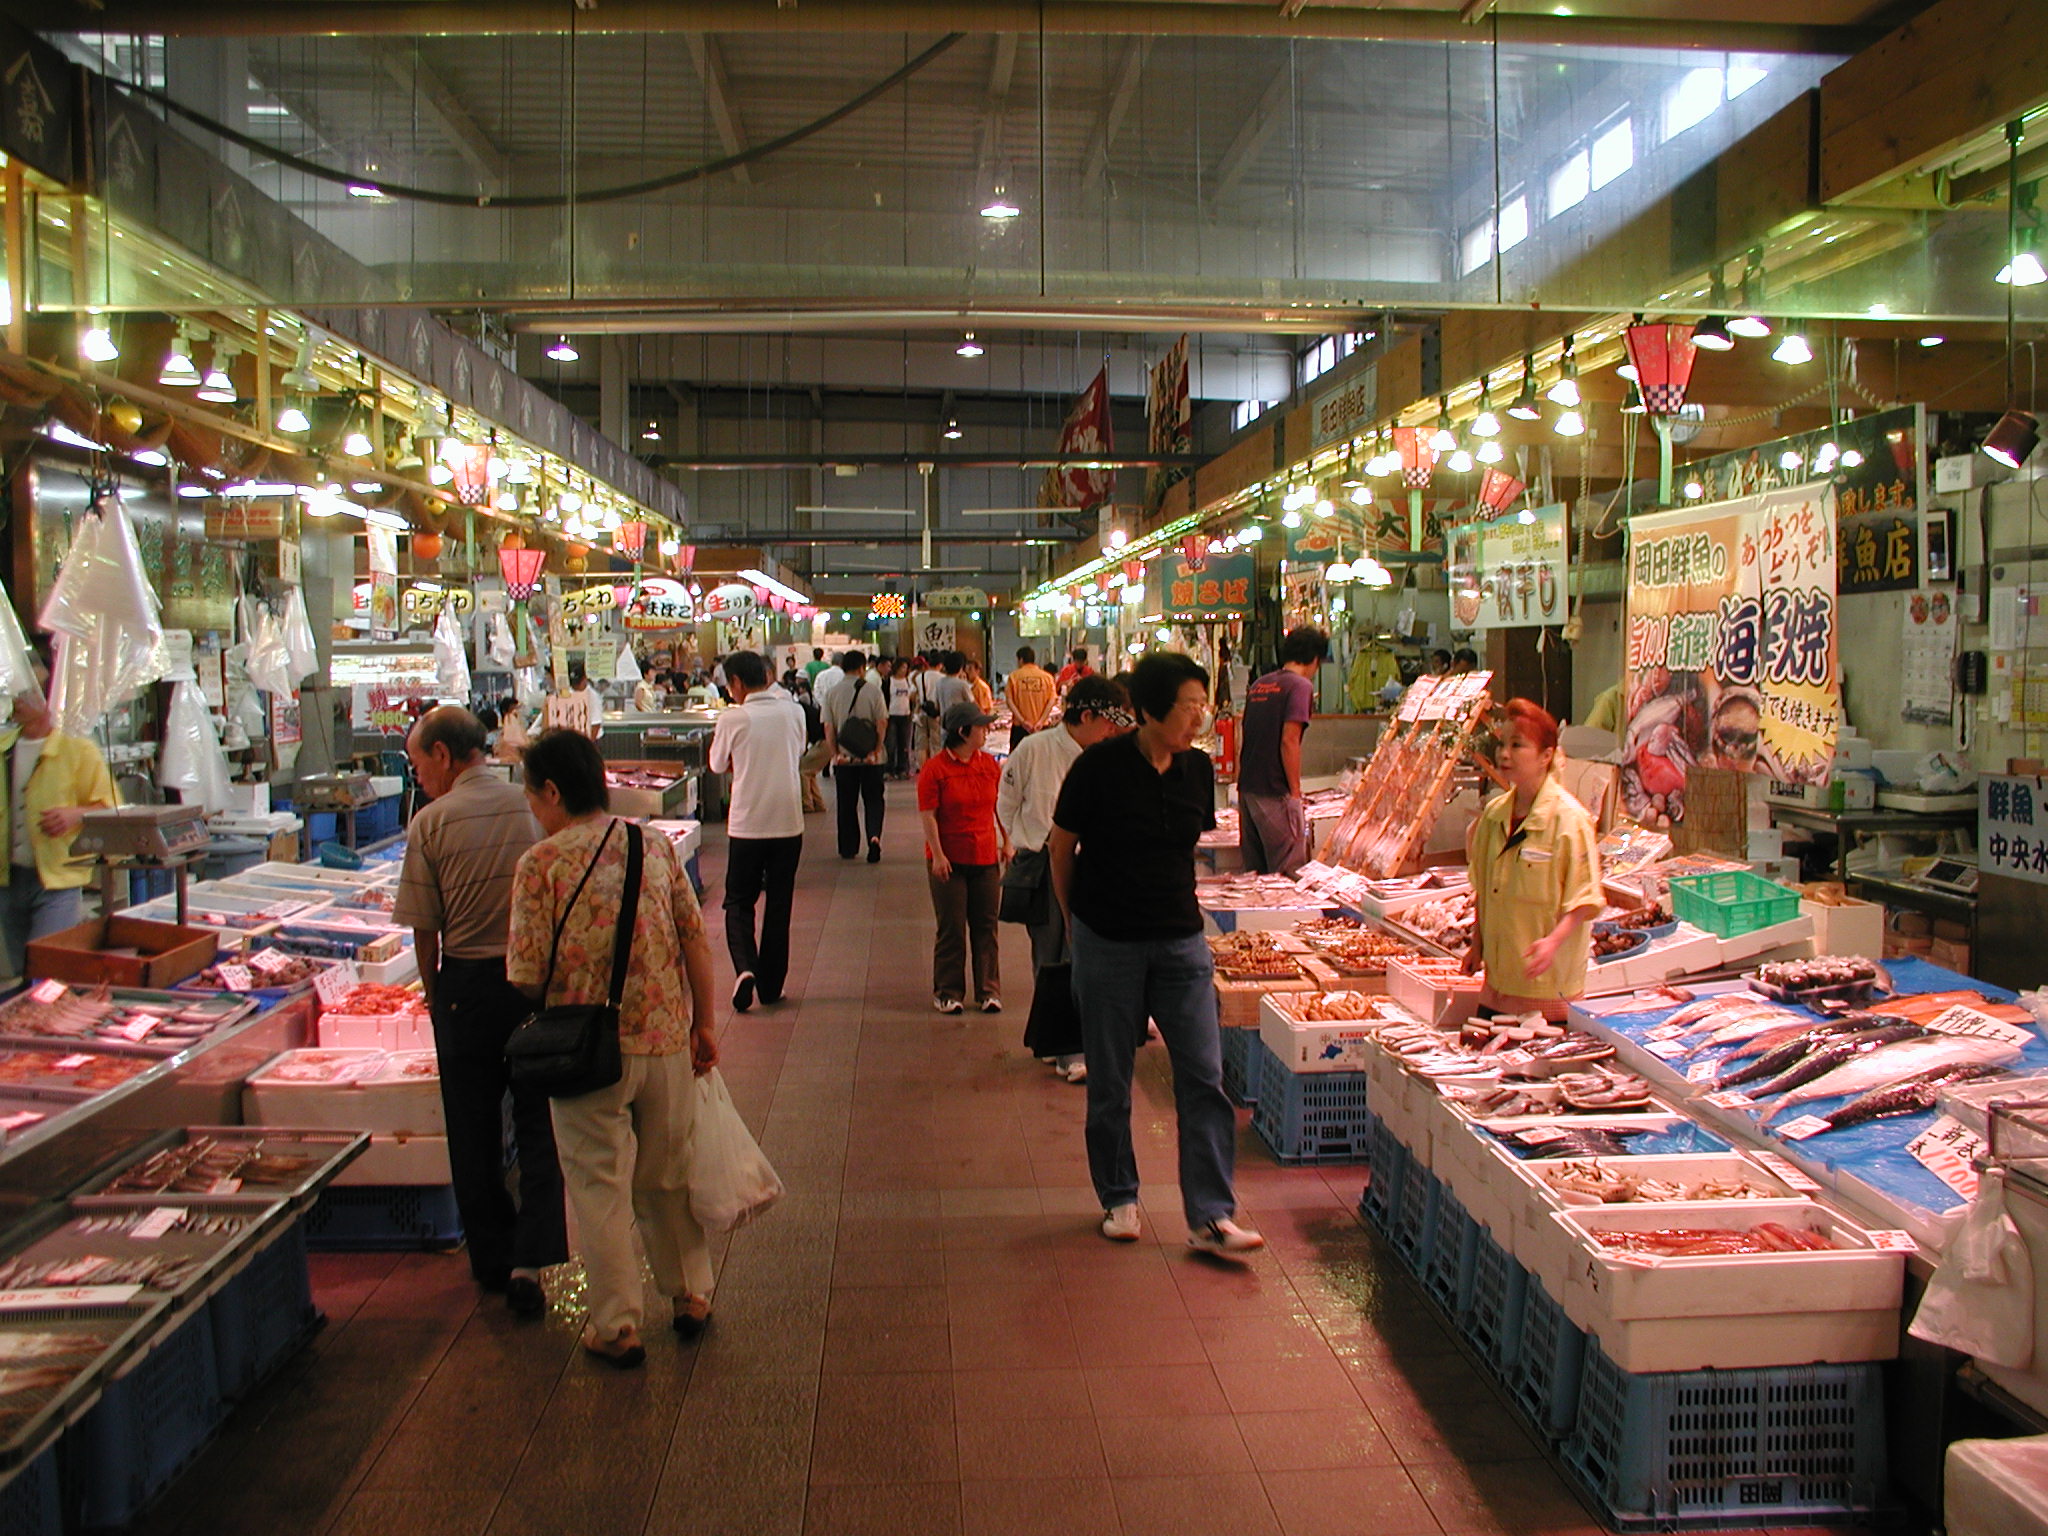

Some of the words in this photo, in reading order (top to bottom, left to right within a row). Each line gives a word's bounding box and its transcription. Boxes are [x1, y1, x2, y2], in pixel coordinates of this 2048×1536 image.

[1633, 531, 1728, 588] 岡田鮮魚の
[563, 590, 613, 613] ちくわ
